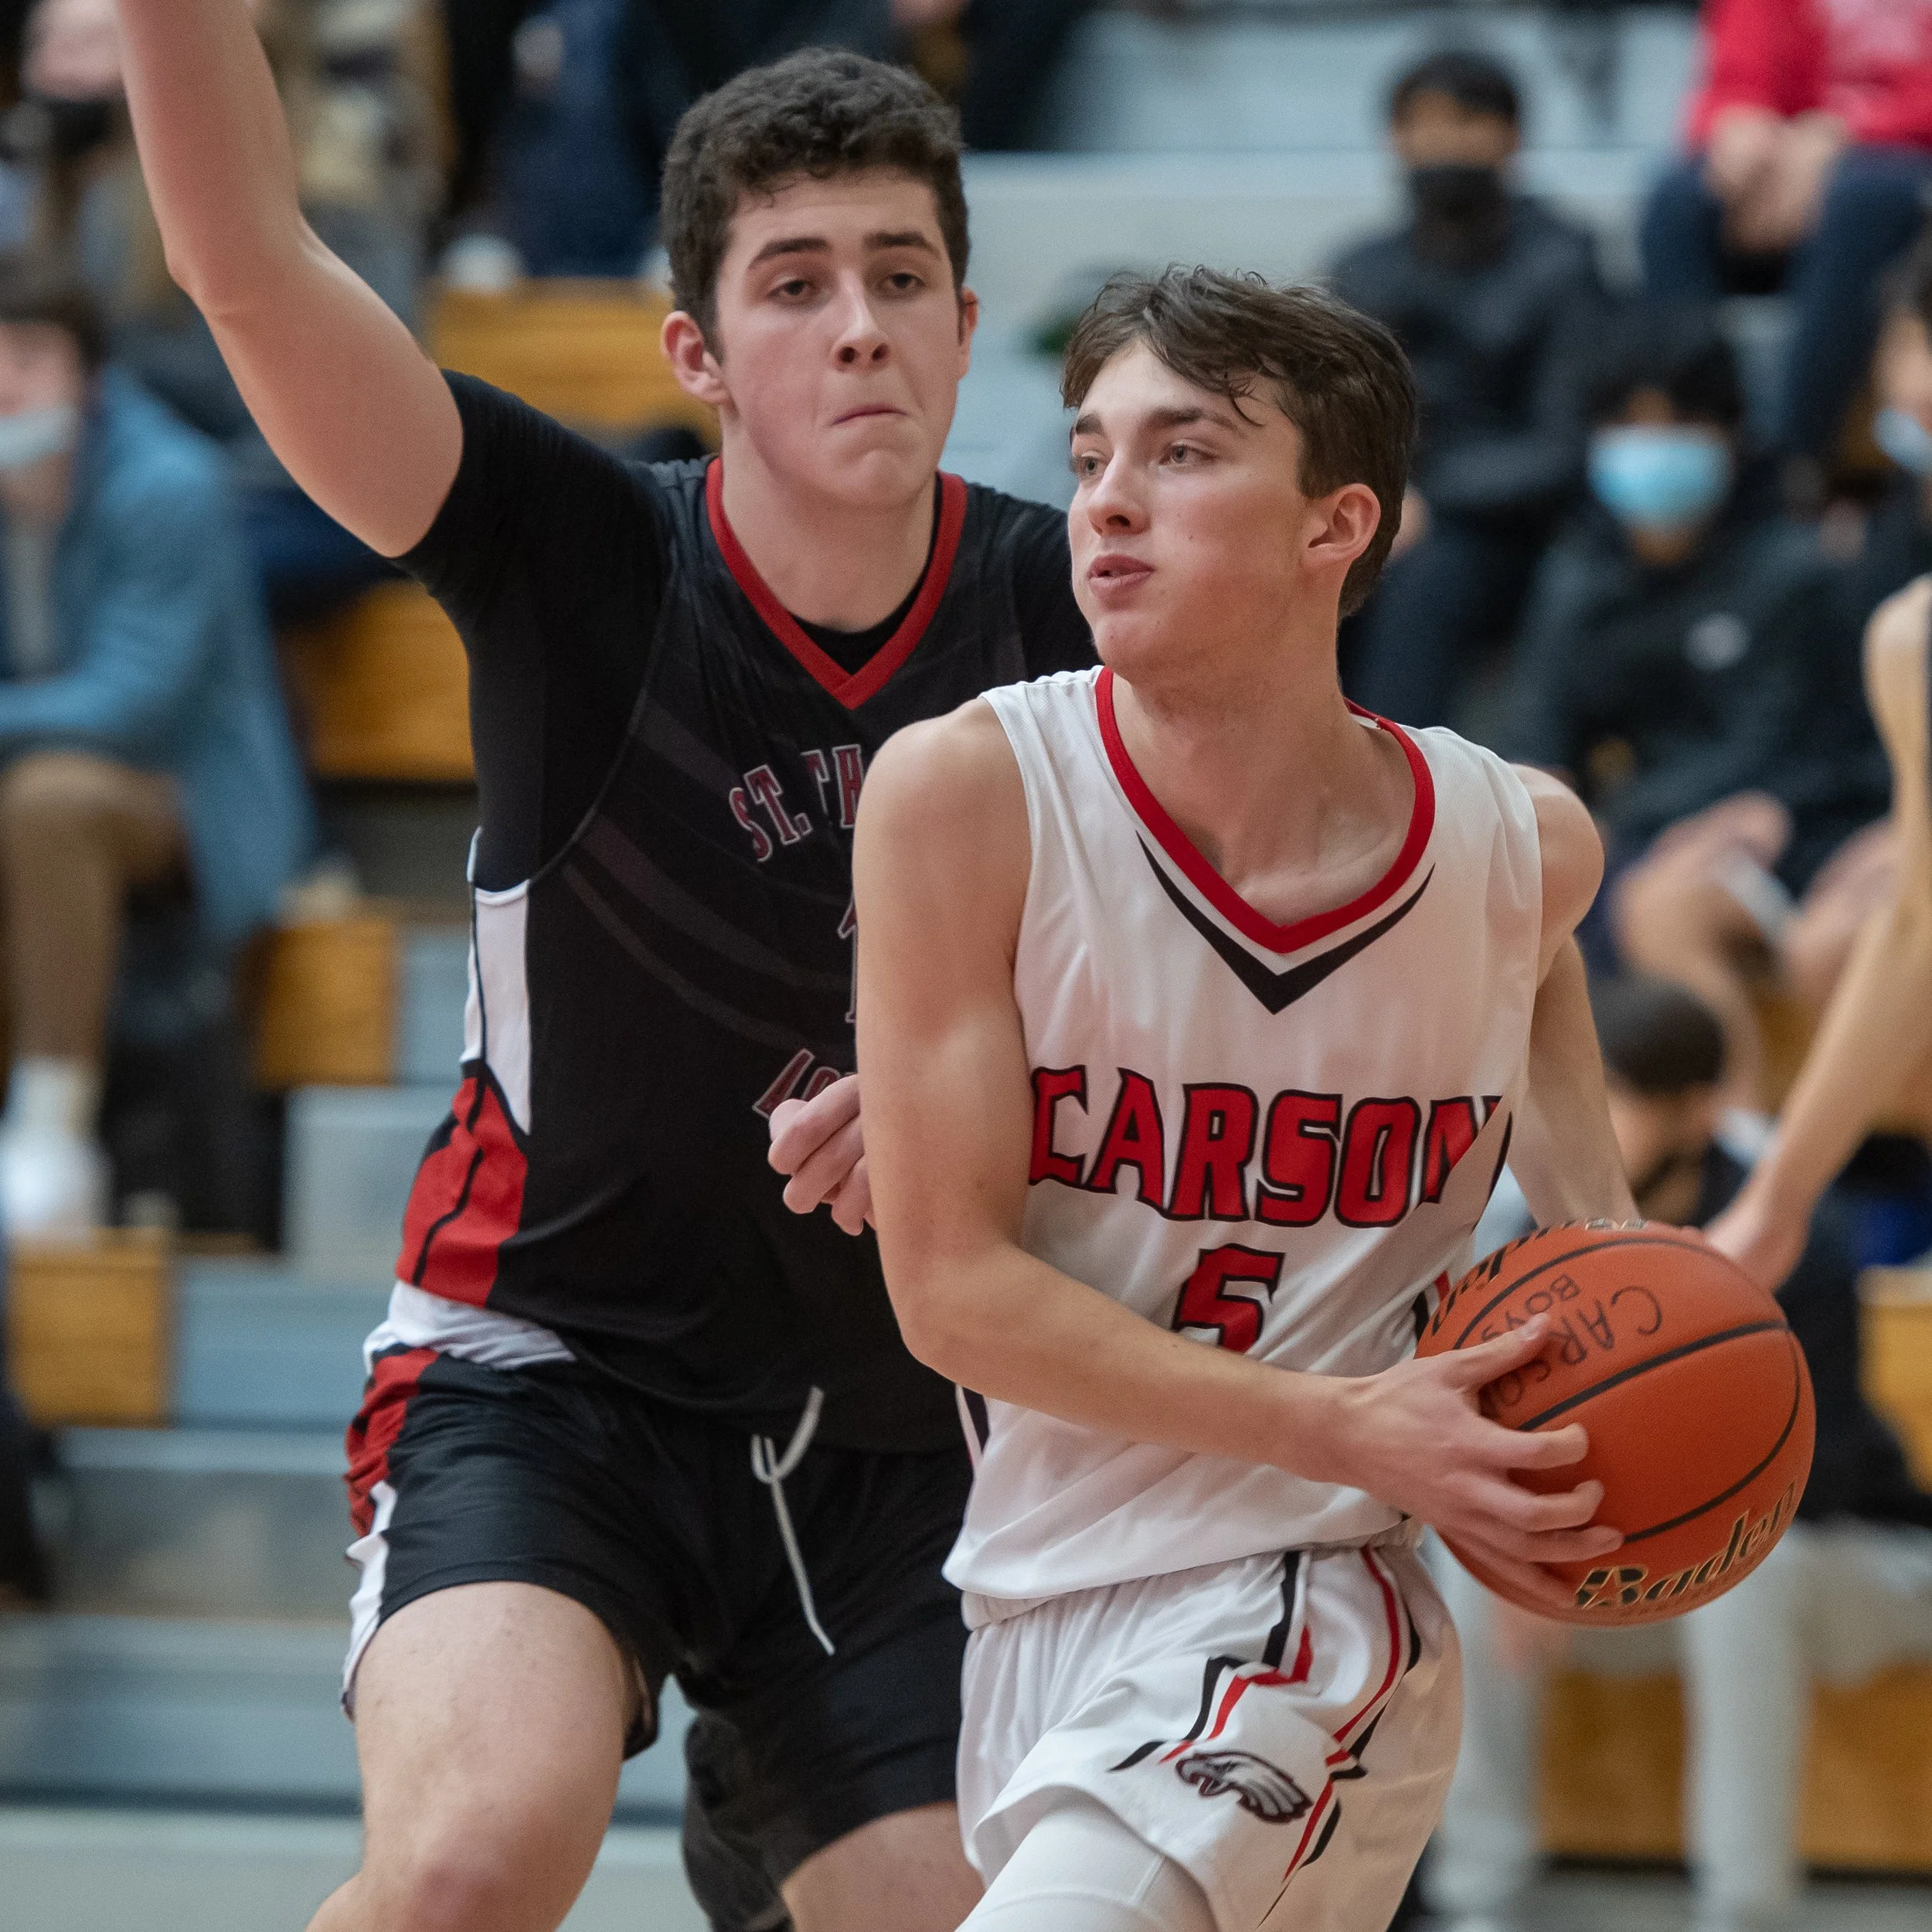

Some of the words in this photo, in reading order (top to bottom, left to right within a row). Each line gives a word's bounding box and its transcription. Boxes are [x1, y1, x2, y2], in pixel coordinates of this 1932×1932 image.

[729, 764, 812, 862] ST.
[1029, 1064, 1503, 1228] CARSON
[1171, 1242, 1286, 1355] 5
